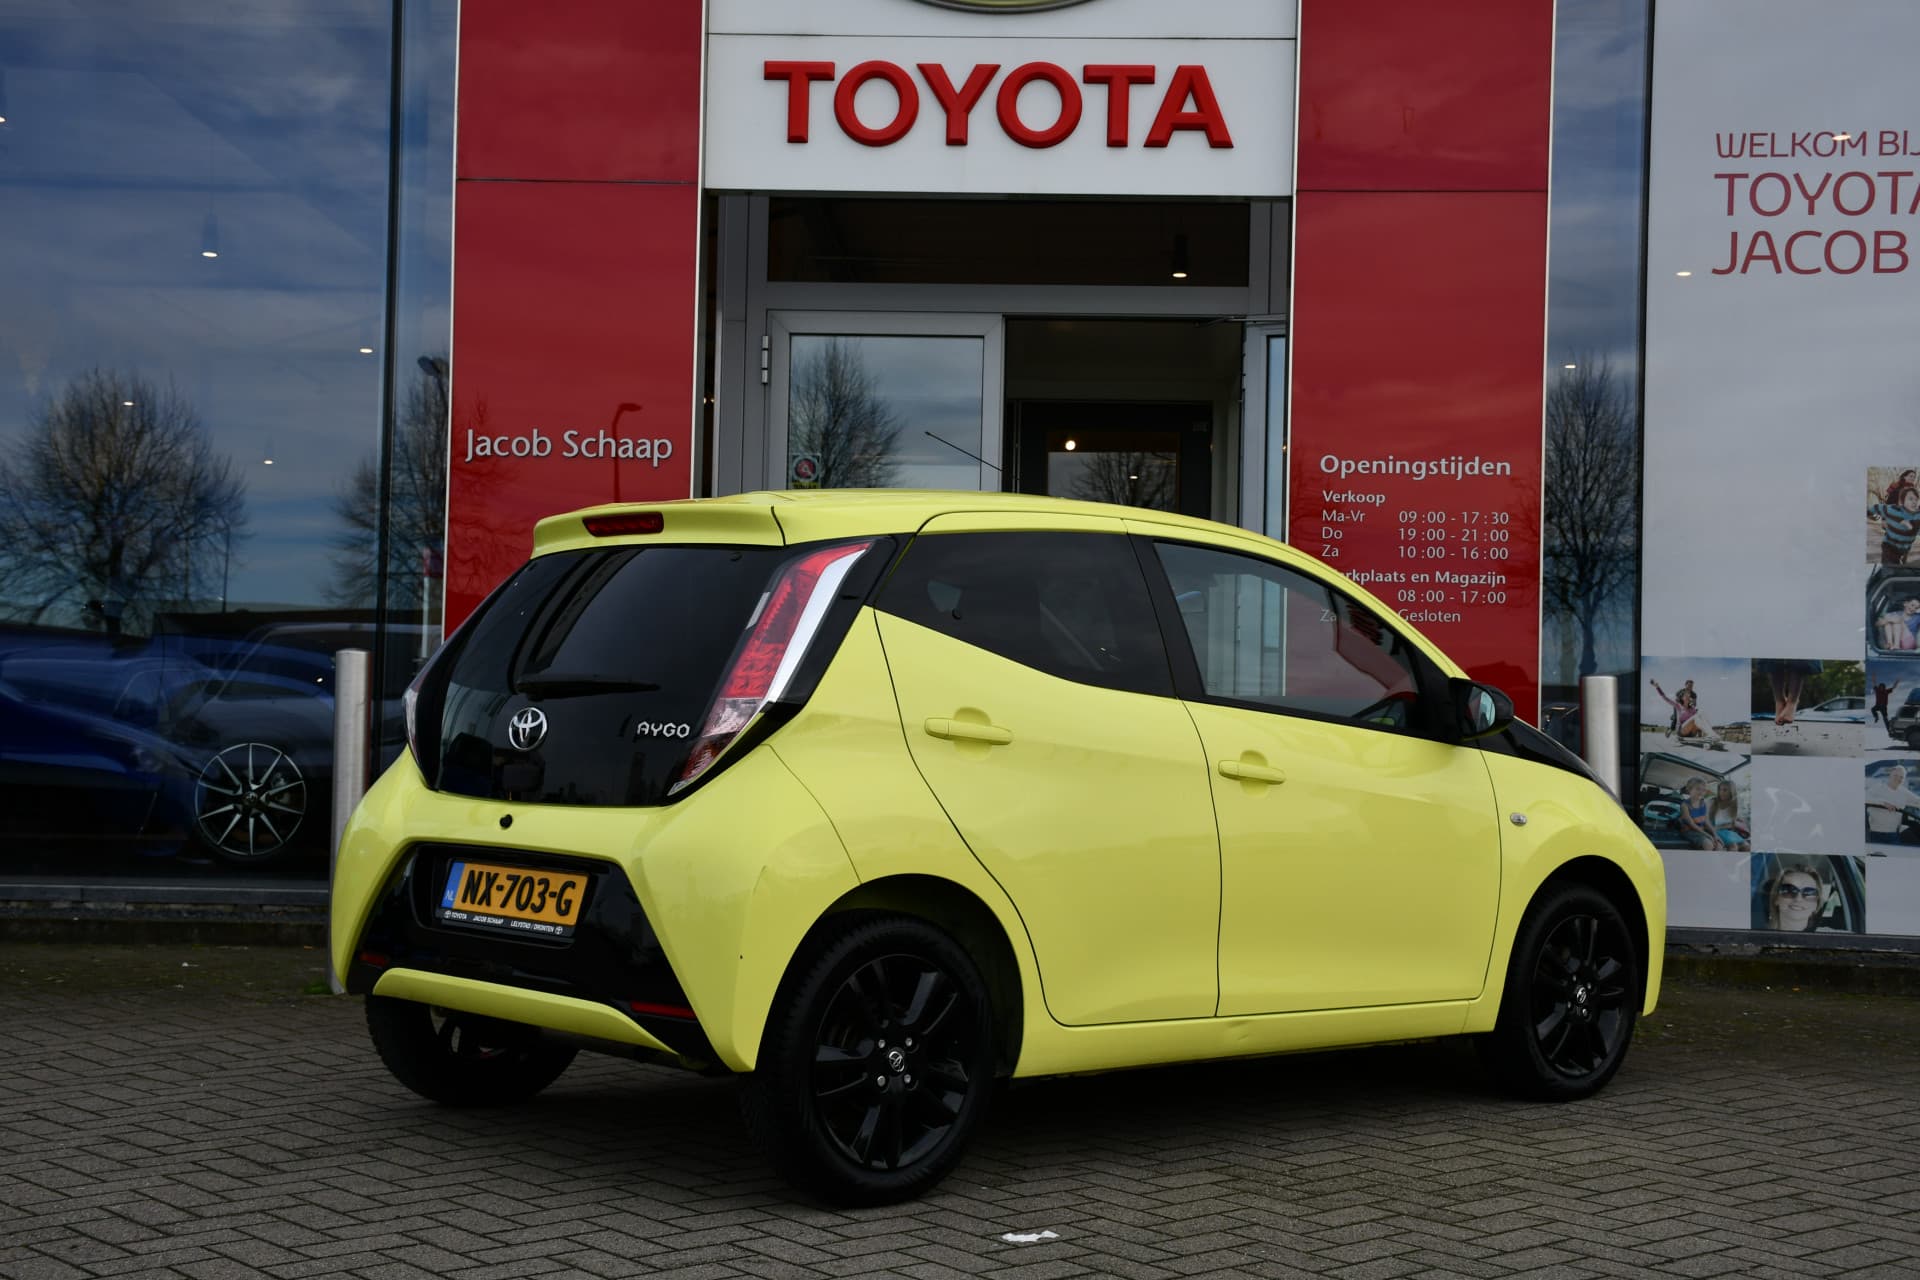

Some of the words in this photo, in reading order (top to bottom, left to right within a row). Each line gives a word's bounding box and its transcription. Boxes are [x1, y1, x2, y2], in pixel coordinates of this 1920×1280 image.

[764, 60, 1234, 149] TOYOTA
[1716, 131, 1867, 158] WELKOM
[1712, 230, 1909, 275] JACOB
[465, 428, 552, 463] Jacob
[562, 428, 673, 468] Schaap
[1320, 455, 1511, 480] Openingstijden
[1322, 490, 1386, 507] Verkoop
[1322, 510, 1366, 523] Ma-Vr
[1321, 527, 1343, 540] Do
[1321, 545, 1340, 558] Za
[1341, 569, 1406, 586] rkplaats
[1411, 572, 1430, 583] en
[1435, 571, 1506, 588] Magazijn
[637, 721, 690, 738] AYGO
[461, 869, 577, 917] NX-703-G
[451, 911, 467, 920] TOYOTA
